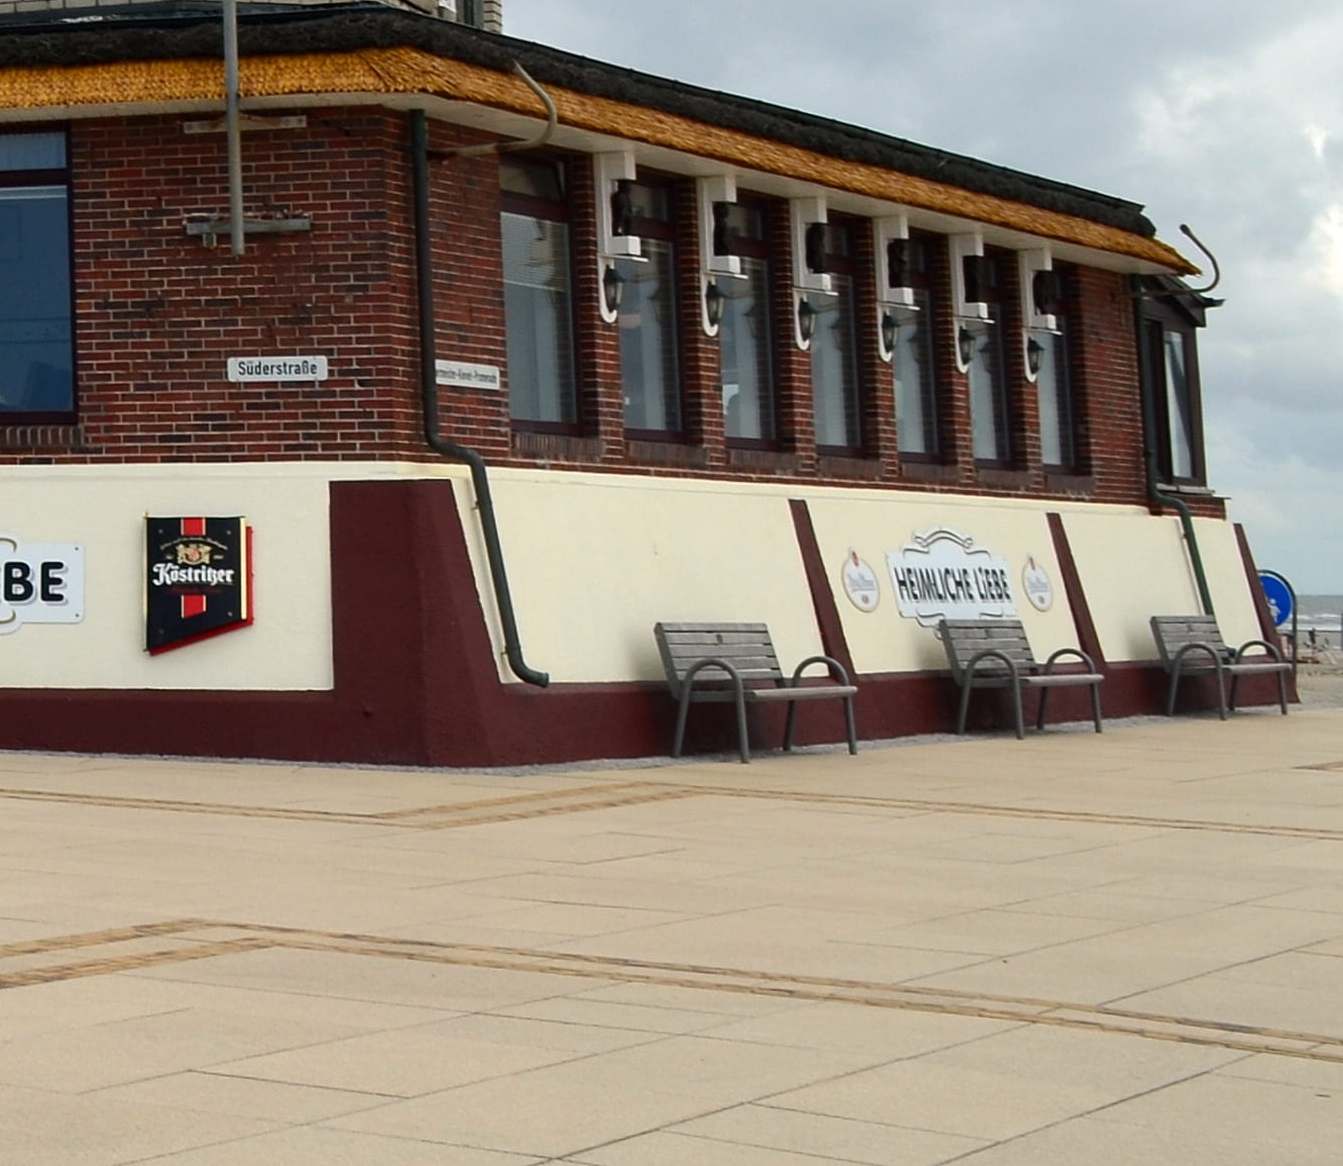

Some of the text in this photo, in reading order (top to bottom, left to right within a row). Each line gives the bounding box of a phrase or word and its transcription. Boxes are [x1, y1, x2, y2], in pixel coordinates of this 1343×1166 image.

[238, 360, 317, 375] Süderstraße
[152, 563, 234, 585] Köstritzer
[894, 567, 974, 602] HEIMLICHE
